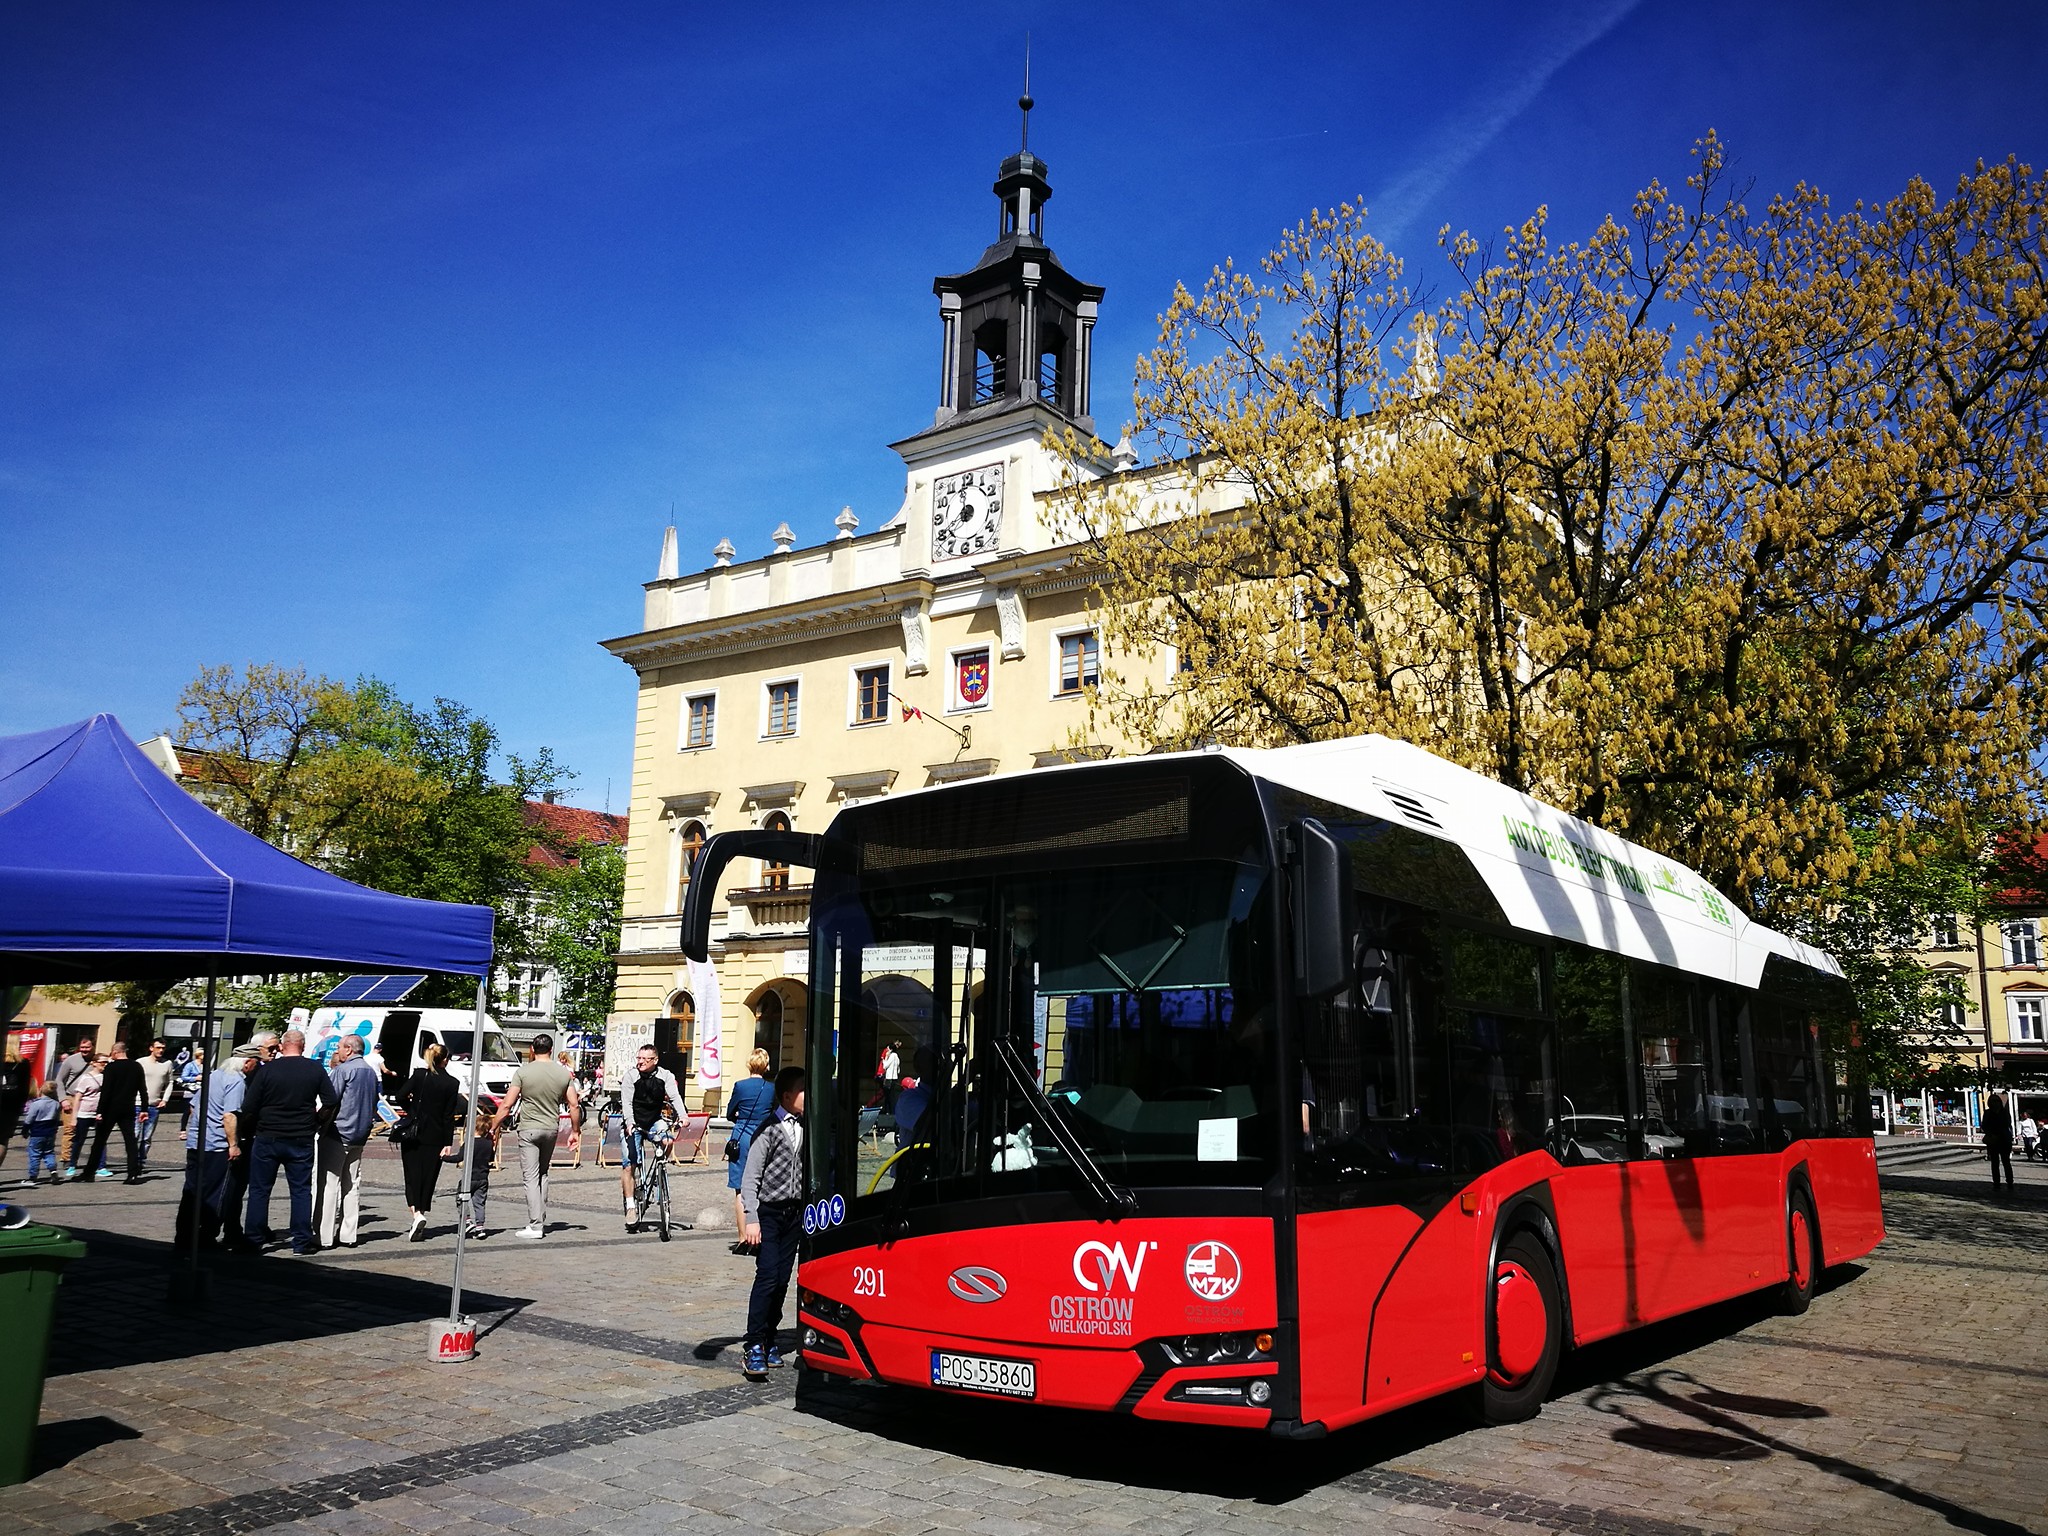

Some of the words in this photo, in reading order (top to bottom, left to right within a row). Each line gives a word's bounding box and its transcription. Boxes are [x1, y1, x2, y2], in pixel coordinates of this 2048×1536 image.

[1502, 814, 1575, 868] AUTOBUS
[853, 1266, 887, 1297] 291
[1192, 1276, 1235, 1298] MZK
[1050, 1291, 1134, 1321] OSTRÓW
[1184, 1303, 1245, 1317] OSTRÓW
[1048, 1319, 1132, 1336] WIELKOPOLSKI
[941, 1355, 973, 1381] POS
[979, 1360, 1031, 1388] 55860
